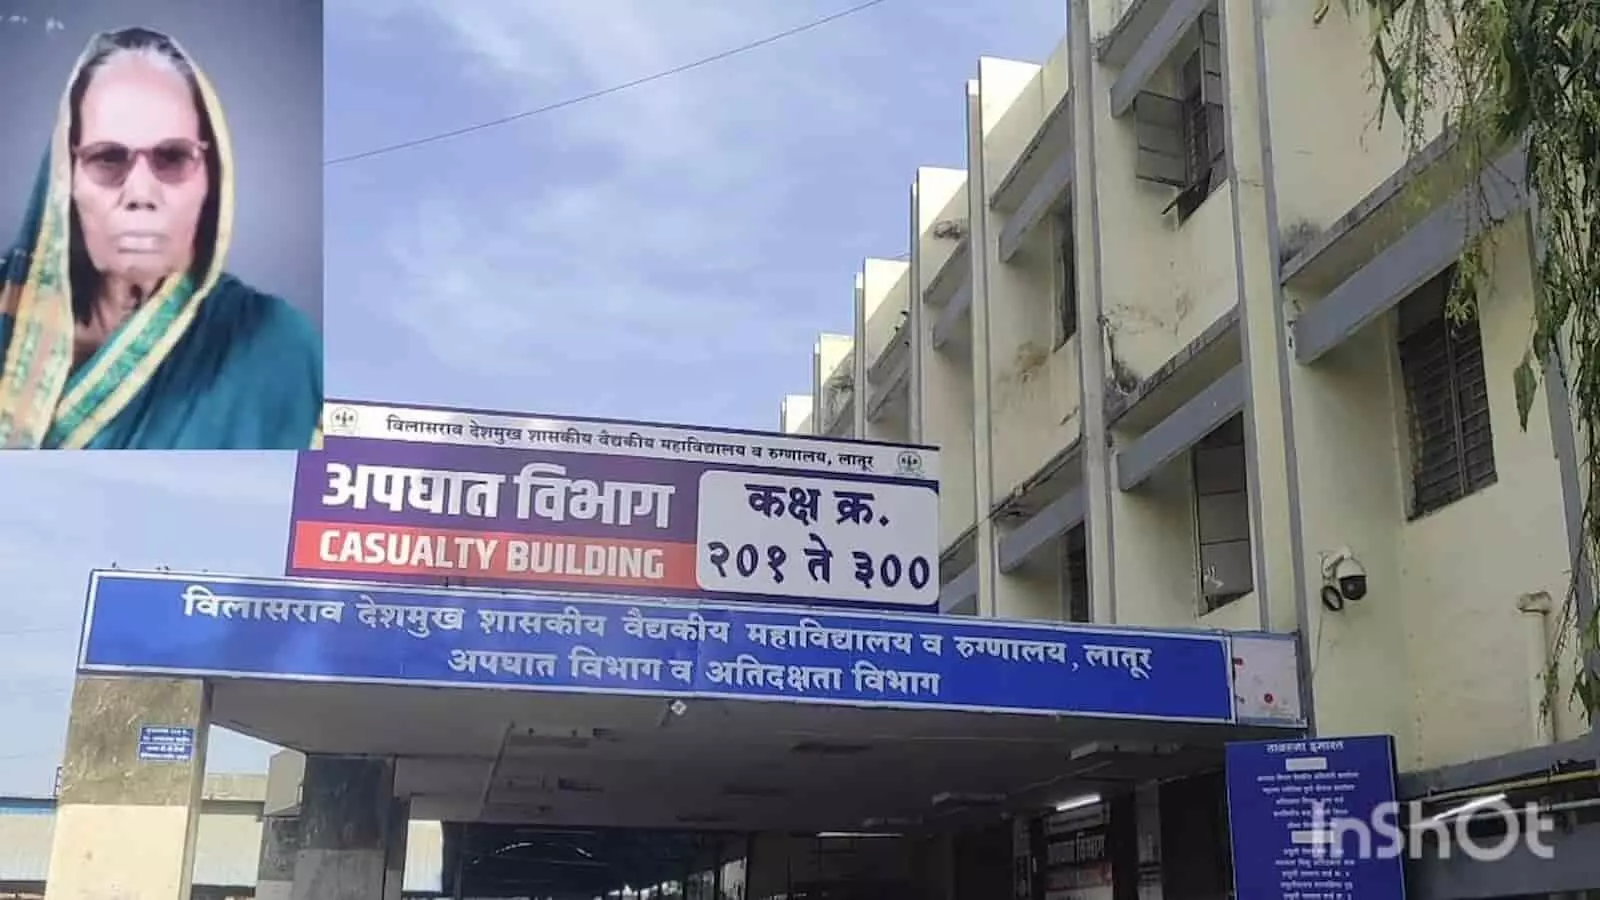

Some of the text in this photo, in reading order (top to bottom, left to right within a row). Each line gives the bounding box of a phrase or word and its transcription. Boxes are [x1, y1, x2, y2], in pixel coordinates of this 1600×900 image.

[386, 414, 464, 438] विलासराव
[469, 418, 523, 446] देशमुख
[527, 428, 593, 446] शासकीय
[660, 436, 746, 457] महाविद्यालय
[751, 445, 763, 459] व
[838, 453, 875, 472] लातूर
[322, 462, 676, 529] अपघात विभाग
[744, 483, 890, 527] कक्ष क्र.
[319, 529, 664, 579] CASUALTY BUILDING
[708, 533, 931, 590] २०१ ते ३००
[181, 585, 345, 624] विलासराव
[356, 594, 466, 638] देशमुख
[478, 606, 607, 637] शासकीय
[621, 608, 730, 644] वैद्यकीय
[745, 617, 913, 654] महाविद्यालय
[920, 634, 943, 656] व
[1083, 643, 1152, 679] लातूर
[448, 646, 940, 696] अपघात विभाग व अतिदक्षता विभाग
